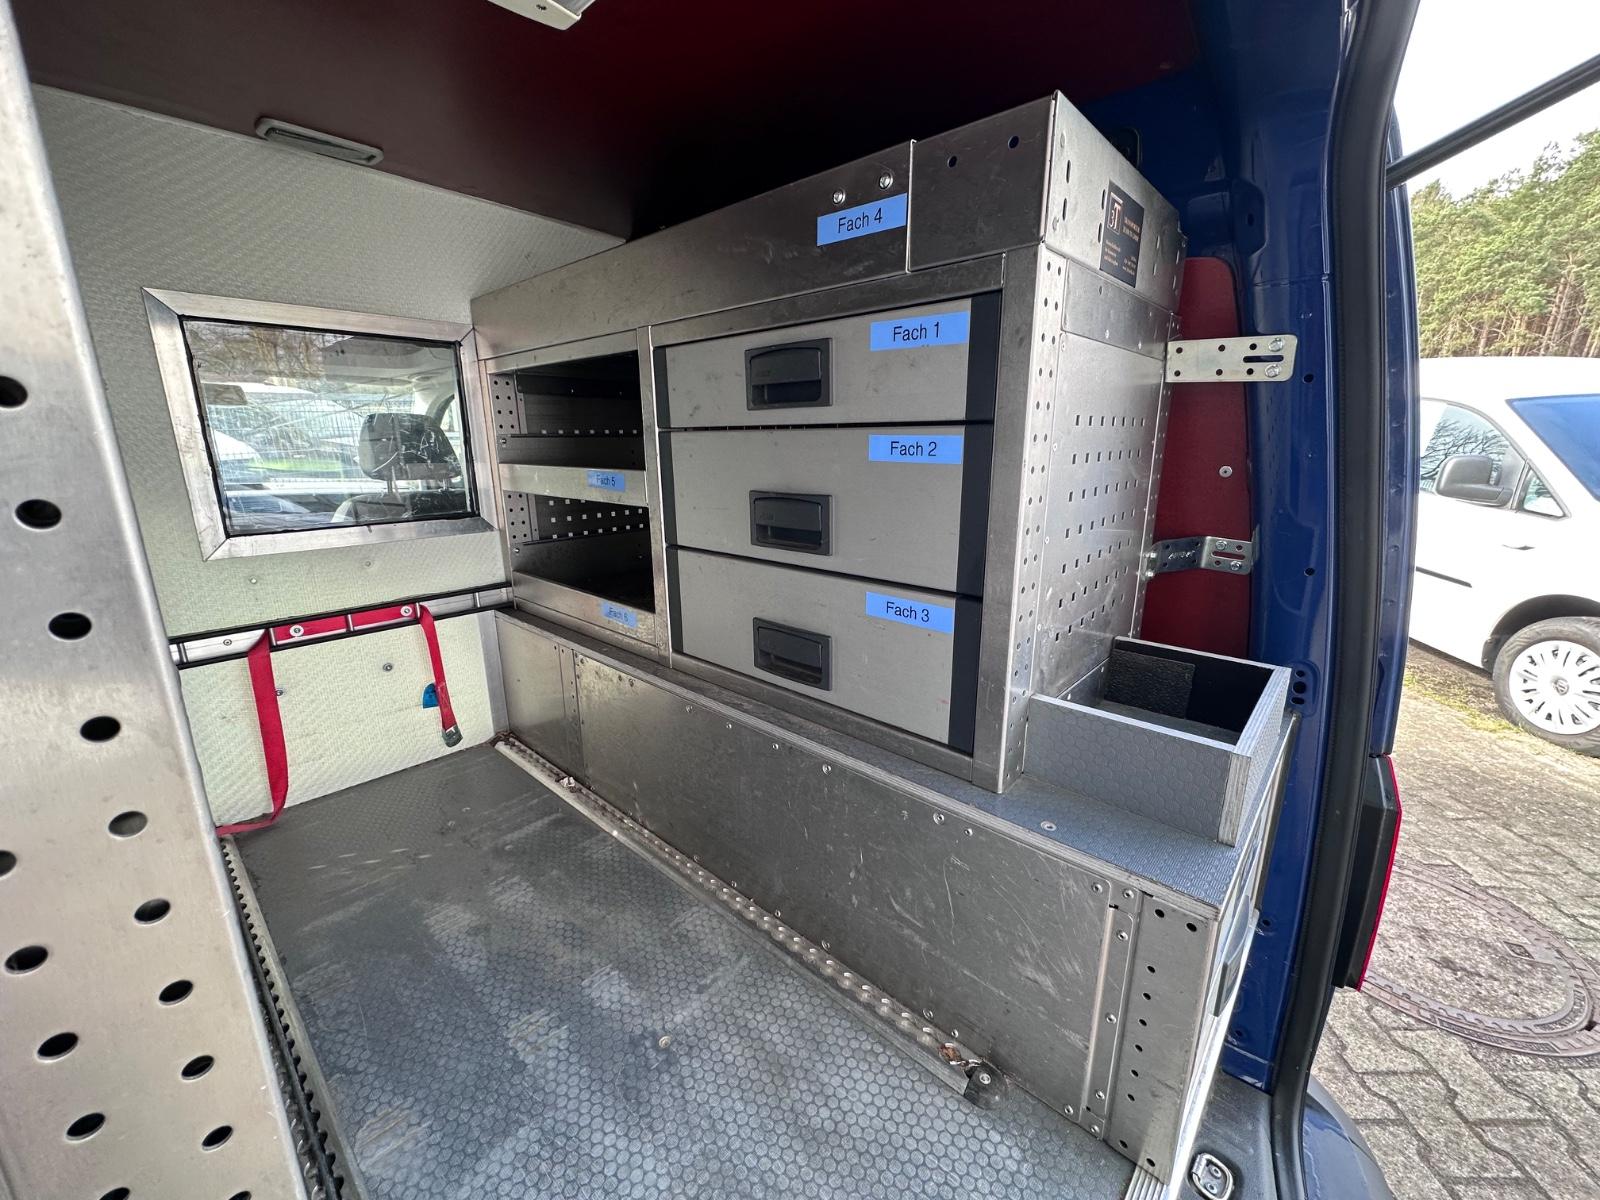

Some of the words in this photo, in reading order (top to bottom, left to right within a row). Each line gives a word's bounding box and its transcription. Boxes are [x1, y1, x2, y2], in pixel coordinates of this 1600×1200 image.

[837, 211, 869, 234] Fach
[874, 207, 883, 224] 4
[893, 323, 927, 342] Fach
[934, 321, 940, 338] 1
[890, 441, 924, 457] Fach
[928, 441, 937, 457] 2
[596, 474, 610, 486] Fach
[611, 476, 616, 488] 5
[885, 601, 917, 620] Fach
[921, 608, 930, 622] 3
